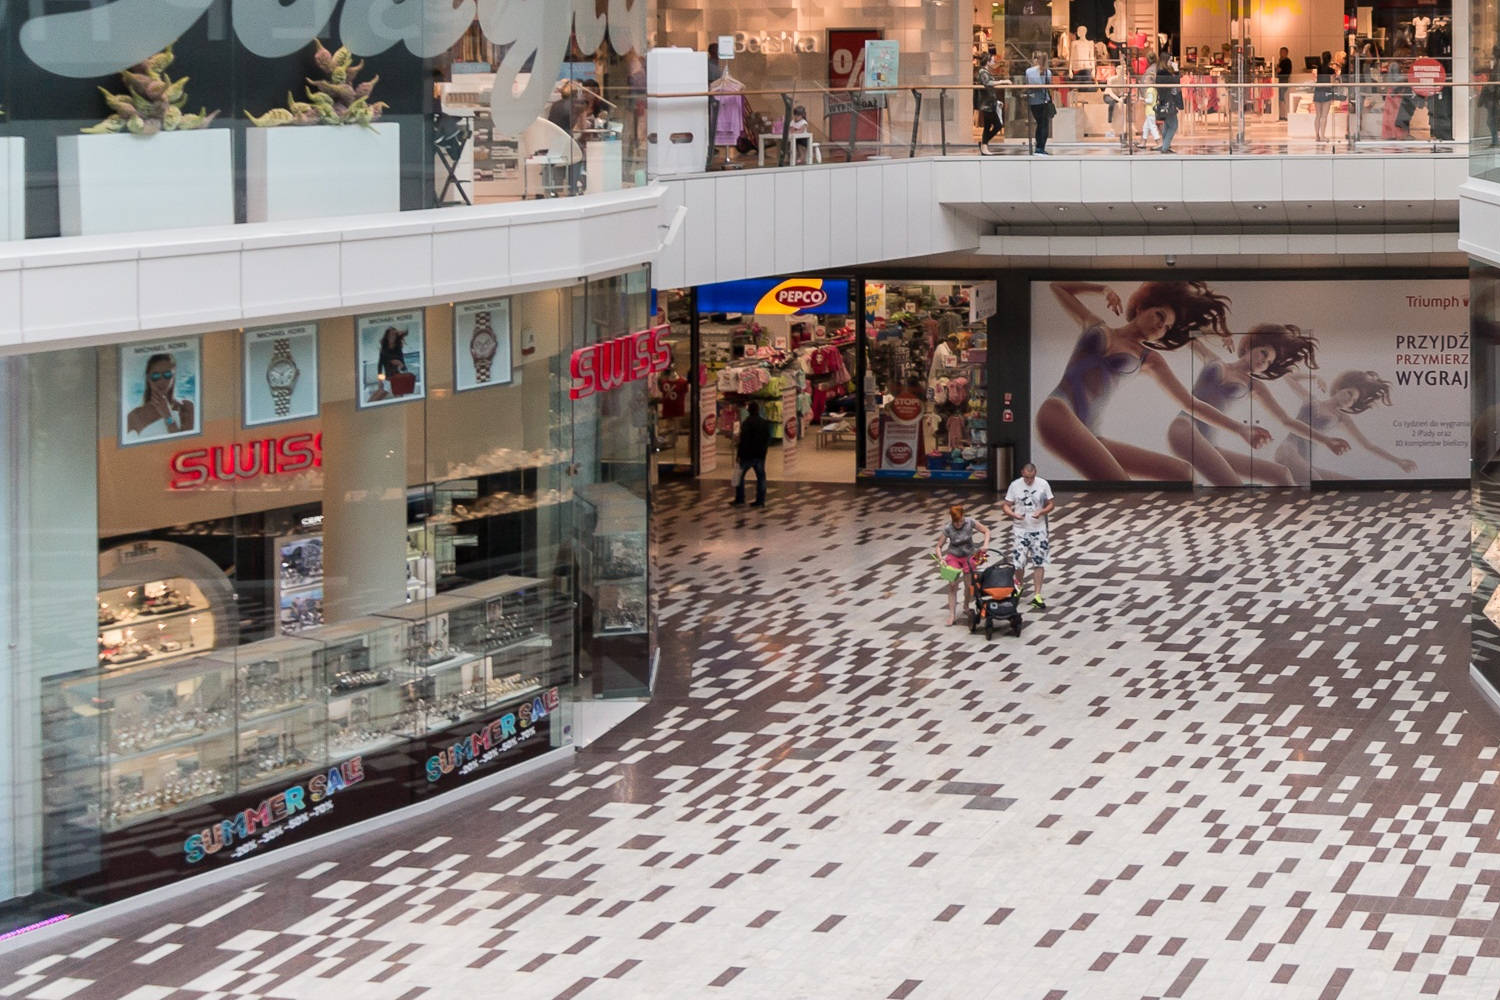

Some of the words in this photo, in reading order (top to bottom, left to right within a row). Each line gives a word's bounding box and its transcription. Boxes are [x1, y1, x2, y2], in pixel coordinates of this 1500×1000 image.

[779, 290, 822, 303] PEPCO
[1406, 296, 1459, 310] Triumph
[1396, 332, 1469, 352] PRZYJDŹ
[570, 324, 672, 400] SWISS
[1396, 354, 1469, 365] PRZYMIERZ
[1396, 371, 1469, 389] WYGRAJ
[426, 712, 517, 782] SUMMER
[518, 686, 560, 728] SALE
[184, 785, 306, 863] SUMMER
[308, 755, 365, 802] SALE
